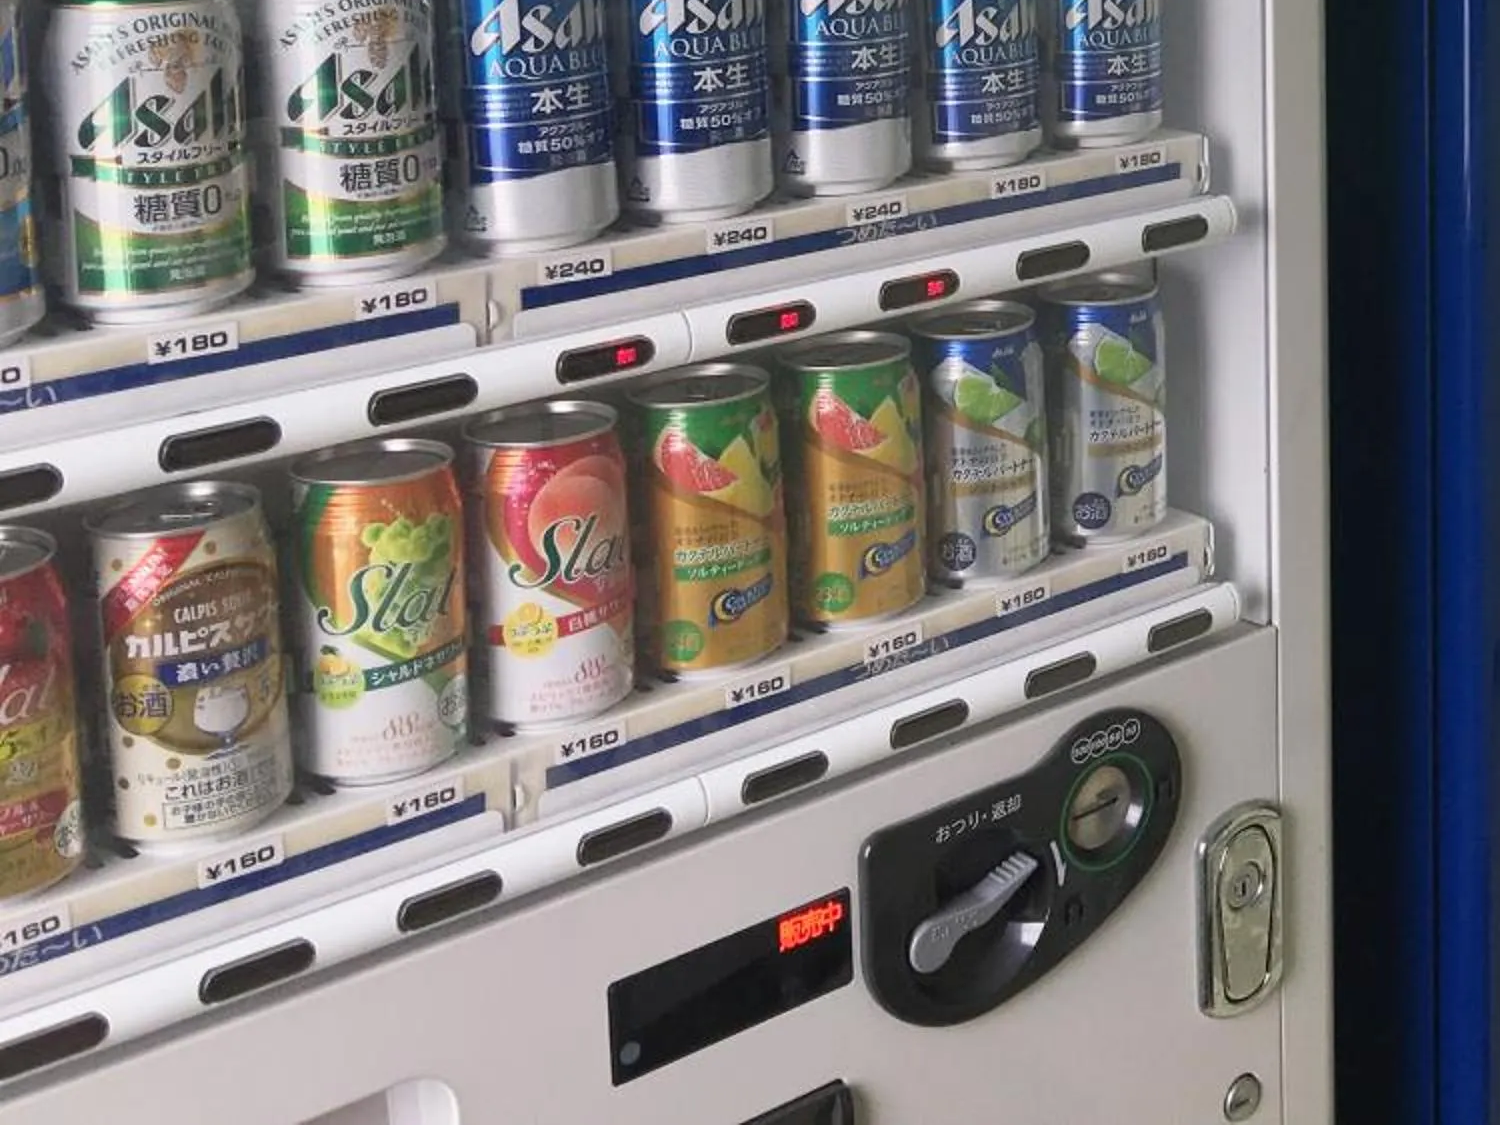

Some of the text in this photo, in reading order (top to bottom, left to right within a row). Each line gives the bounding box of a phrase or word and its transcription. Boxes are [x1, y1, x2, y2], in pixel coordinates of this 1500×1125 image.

[815, 17, 880, 40] AQUA
[1079, 26, 1132, 50] AQUA
[654, 34, 726, 61] AQUA
[850, 44, 899, 71] 本生
[951, 46, 1007, 67] AQUA
[488, 55, 564, 80] AQUA
[1106, 54, 1149, 76] 本生
[693, 65, 752, 93] 本生
[981, 68, 1025, 94] 本生
[530, 84, 592, 116] 本生
[1119, 151, 1161, 169] ¥180
[339, 153, 421, 194] 糖質0
[996, 176, 1041, 194] ¥180
[133, 183, 222, 225] 糖質0
[852, 202, 902, 221] ¥240
[713, 226, 768, 247] ¥240
[544, 259, 606, 281] ¥240
[361, 287, 428, 314] ¥180
[154, 331, 228, 357] ¥180
[1127, 545, 1168, 567] ¥160
[173, 598, 218, 625] CALPIS
[1001, 586, 1046, 612] ¥160
[868, 632, 918, 658] ¥160
[731, 676, 784, 703] ¥160
[113, 690, 168, 719] お酒
[561, 729, 620, 757] ¥160
[393, 787, 456, 817] ¥160
[935, 793, 1022, 845] おつり・返却
[206, 844, 276, 881] ¥160
